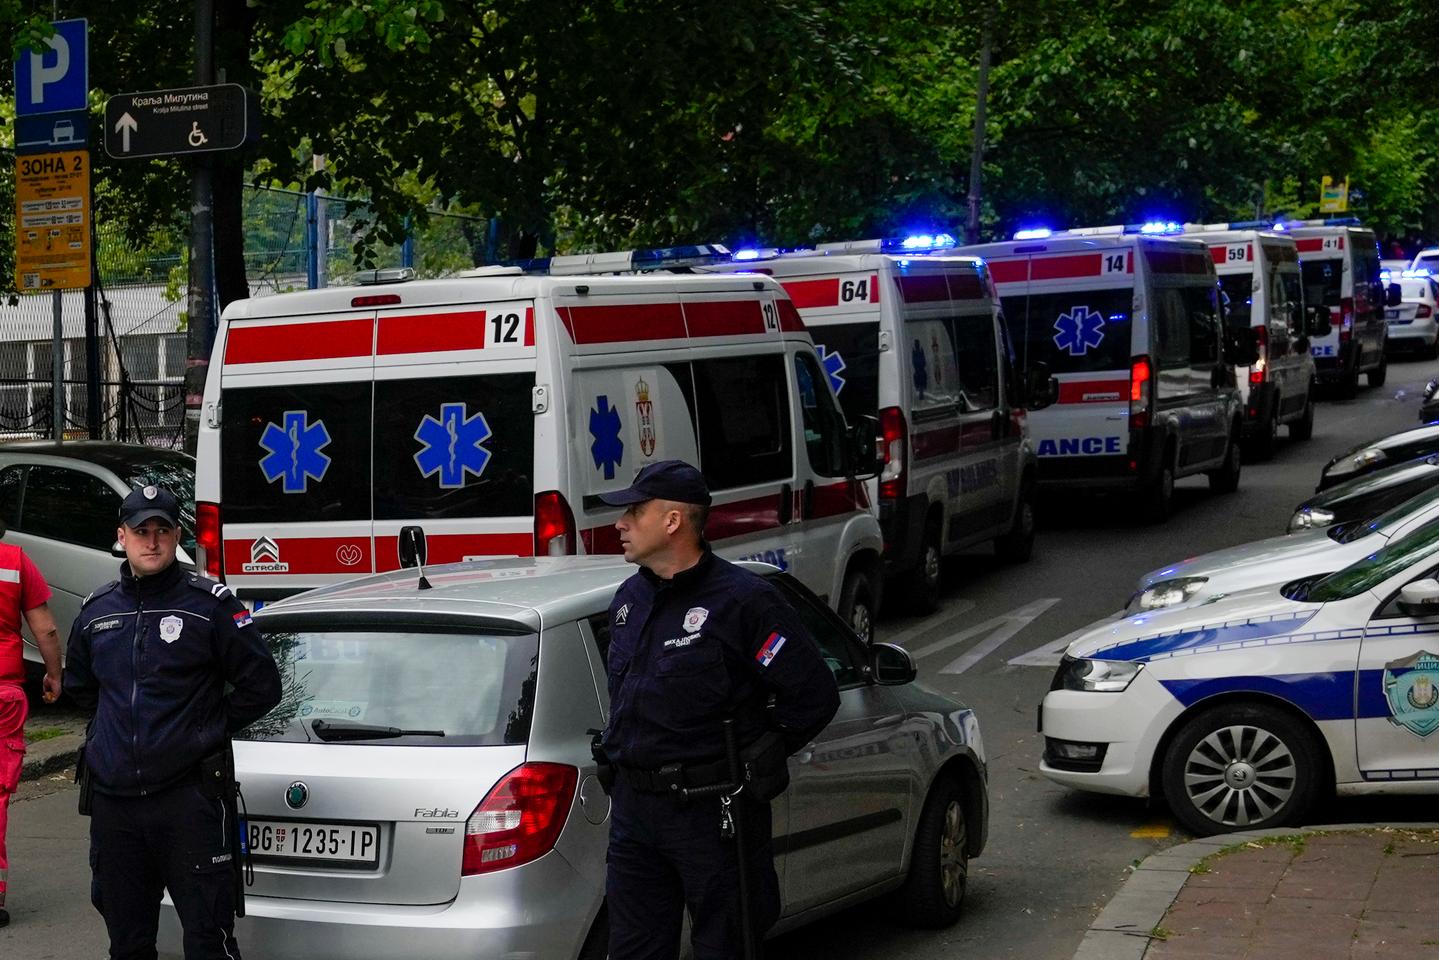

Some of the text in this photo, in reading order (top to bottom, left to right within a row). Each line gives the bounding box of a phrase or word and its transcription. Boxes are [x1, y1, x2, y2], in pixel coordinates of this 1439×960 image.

[30, 33, 70, 104] P
[132, 92, 208, 108] Краља Милутина
[22, 156, 82, 176] ЗОНА 2
[1324, 237, 1337, 249] 41
[1106, 254, 1124, 272] 14
[1228, 248, 1245, 261] 59
[841, 279, 868, 302] 64
[763, 303, 776, 329] 12
[491, 313, 520, 343] 12
[414, 807, 459, 818] Fabia
[250, 825, 272, 851] BG
